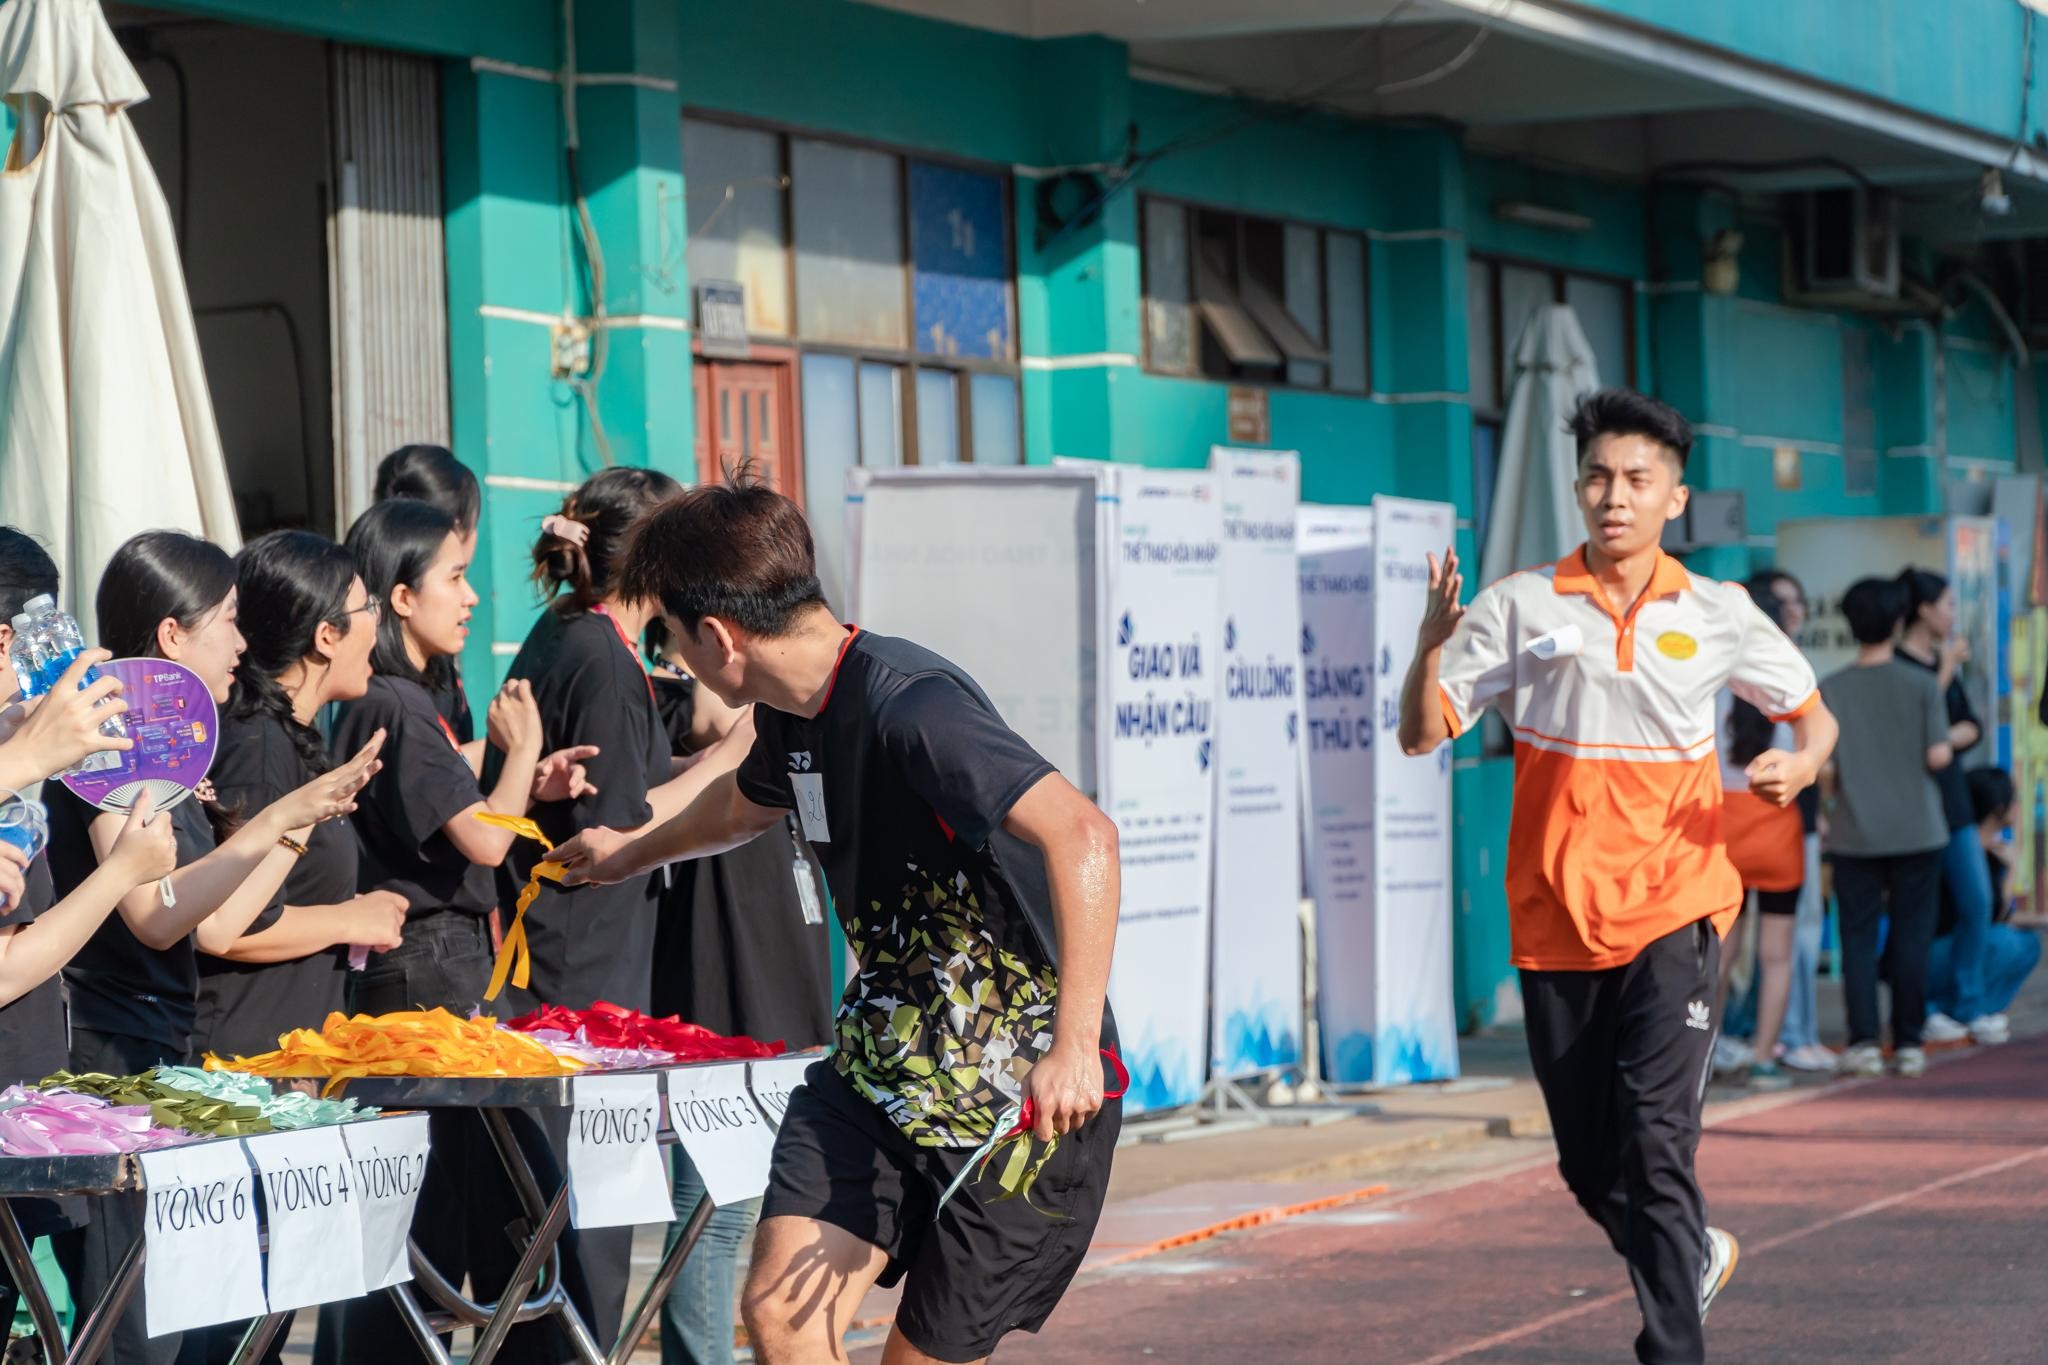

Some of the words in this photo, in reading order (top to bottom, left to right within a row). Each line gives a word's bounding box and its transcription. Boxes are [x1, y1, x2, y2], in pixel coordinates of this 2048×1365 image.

[1128, 645, 1175, 680] GIAO
[579, 1098, 638, 1145] VÒNG
[641, 1107, 653, 1143] 5
[675, 1090, 743, 1136] VÒNG
[737, 1095, 758, 1125] 3
[760, 1081, 791, 1115] VÒ
[267, 1157, 333, 1214] VÒNG
[338, 1162, 349, 1203] 4
[358, 1146, 411, 1200] VÒNG
[412, 1153, 424, 1193] 2
[153, 1175, 225, 1235] VÒNG
[232, 1176, 245, 1221] 6
